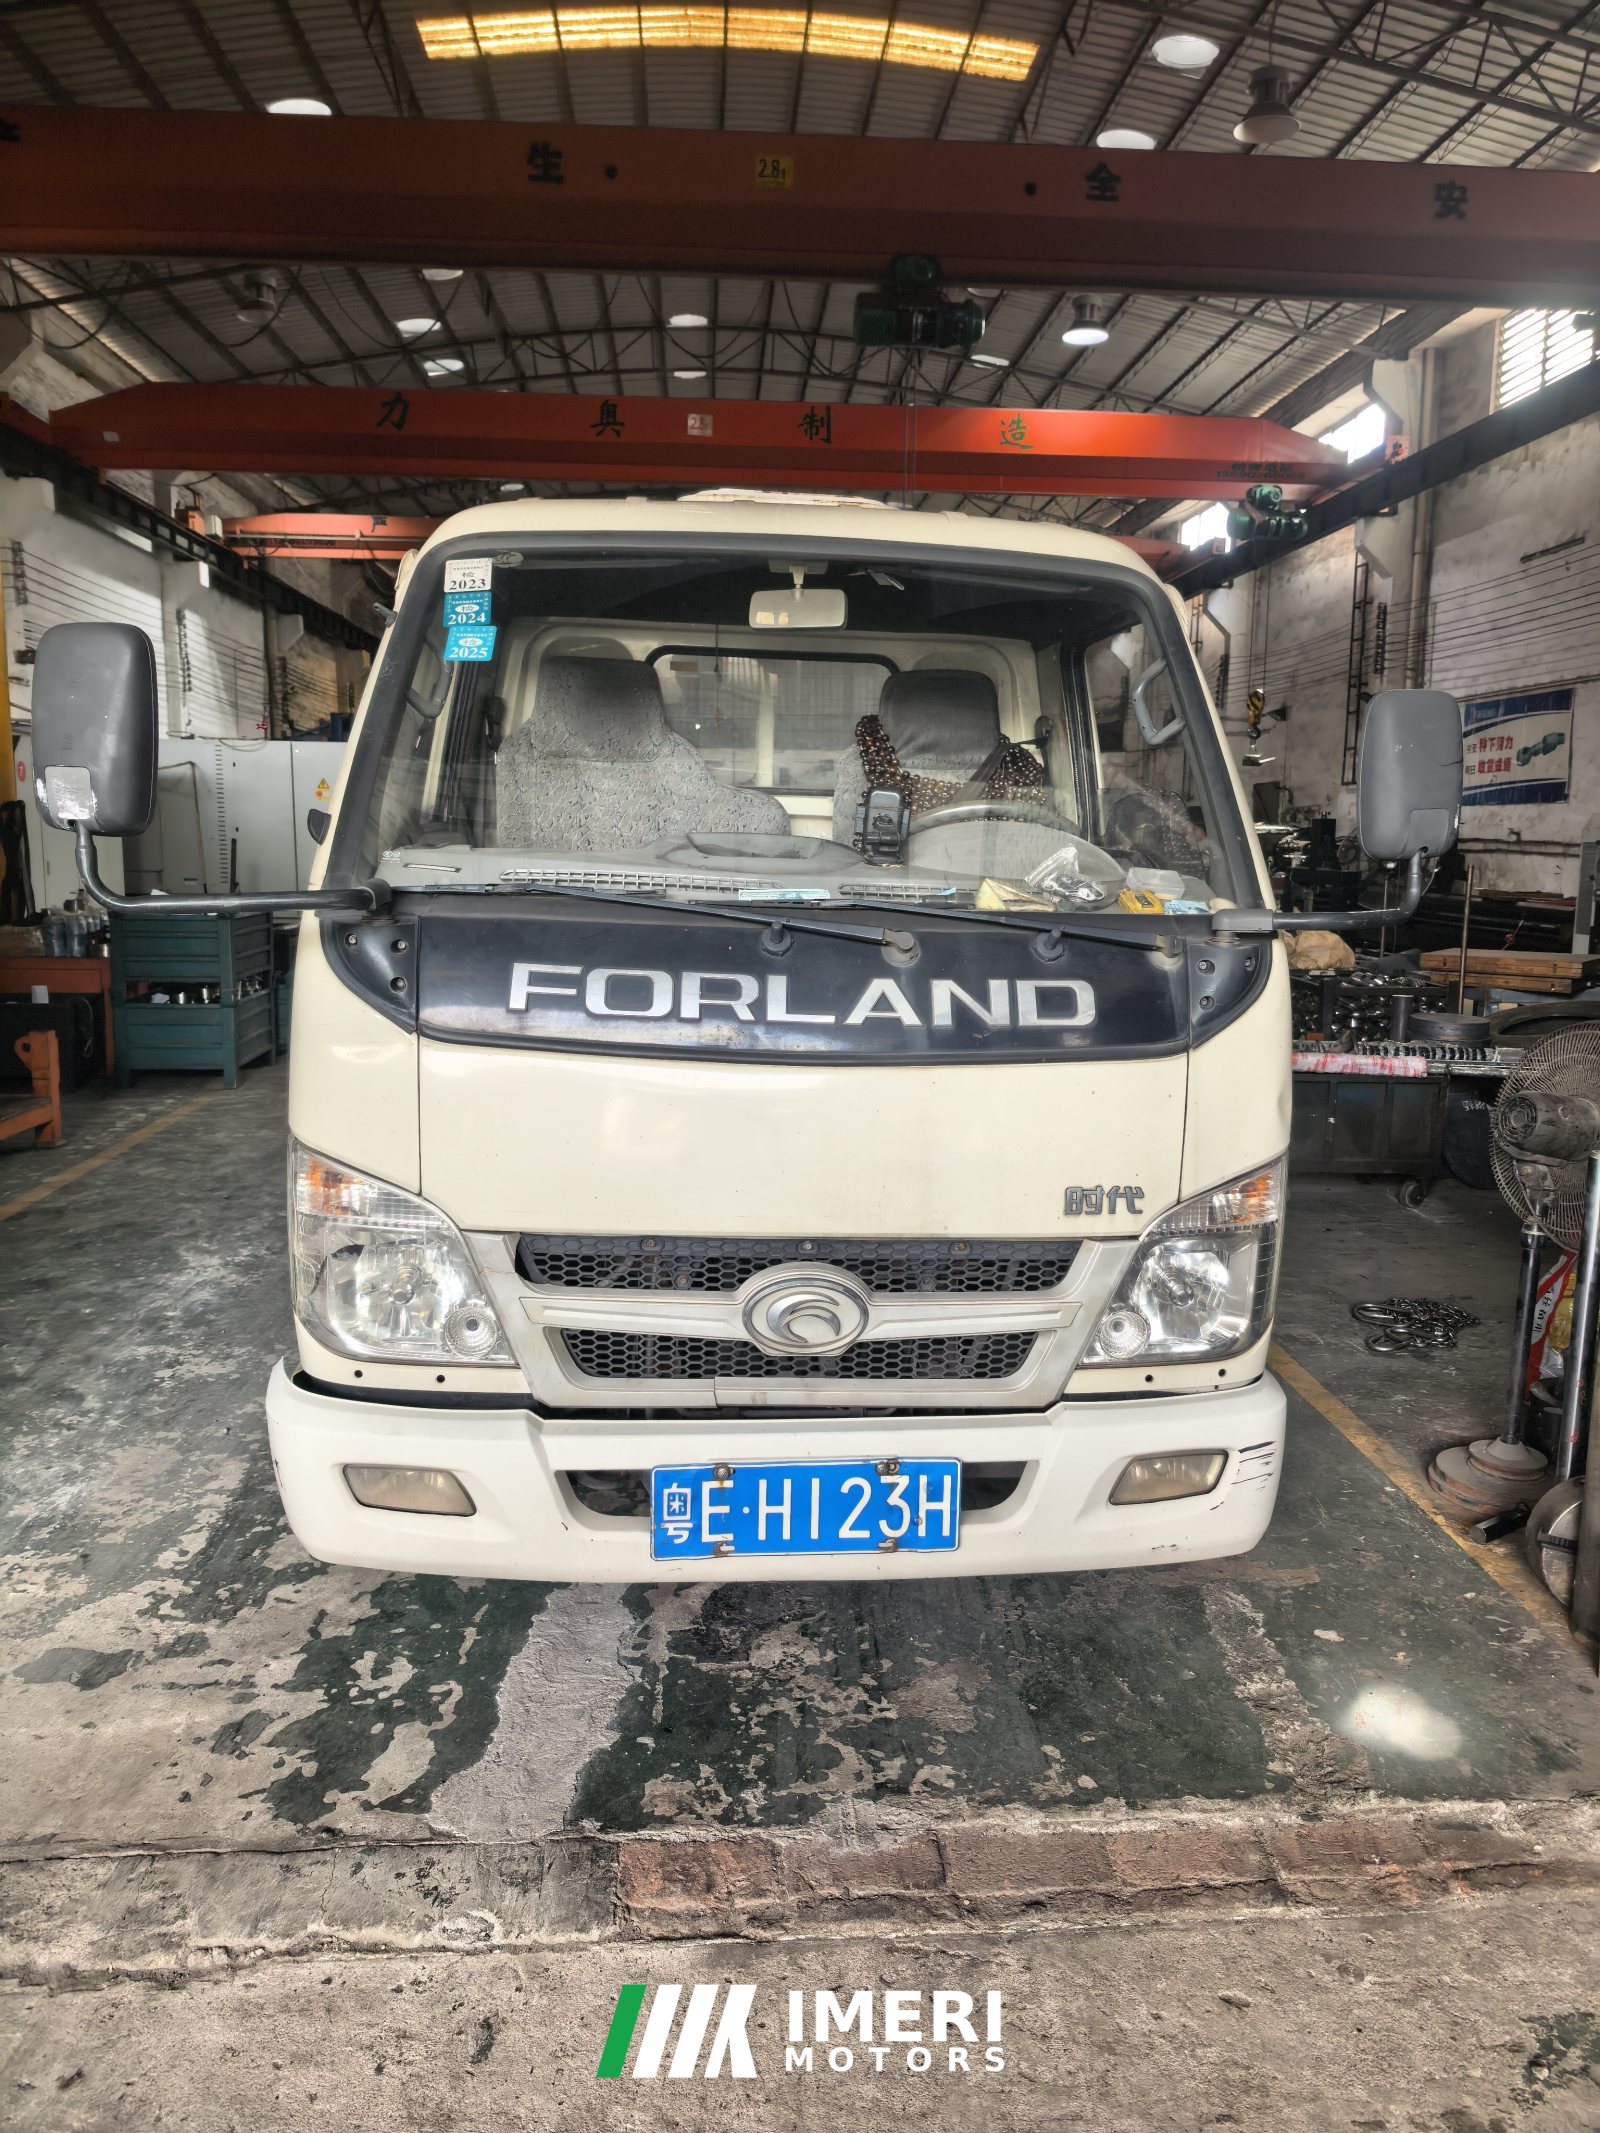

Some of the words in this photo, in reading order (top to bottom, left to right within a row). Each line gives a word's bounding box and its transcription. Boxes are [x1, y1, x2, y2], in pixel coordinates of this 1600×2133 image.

[527, 142, 564, 184] 生
[1085, 162, 1121, 202] 全
[1434, 181, 1469, 220] 安
[376, 391, 410, 431] 力
[798, 406, 831, 443] 制
[999, 413, 1035, 449] 造
[449, 579, 486, 590] 2023
[448, 612, 486, 625] 2024
[449, 647, 488, 659] 2025
[507, 962, 1095, 1028] FORLAND
[1064, 1185, 1144, 1216] 时代
